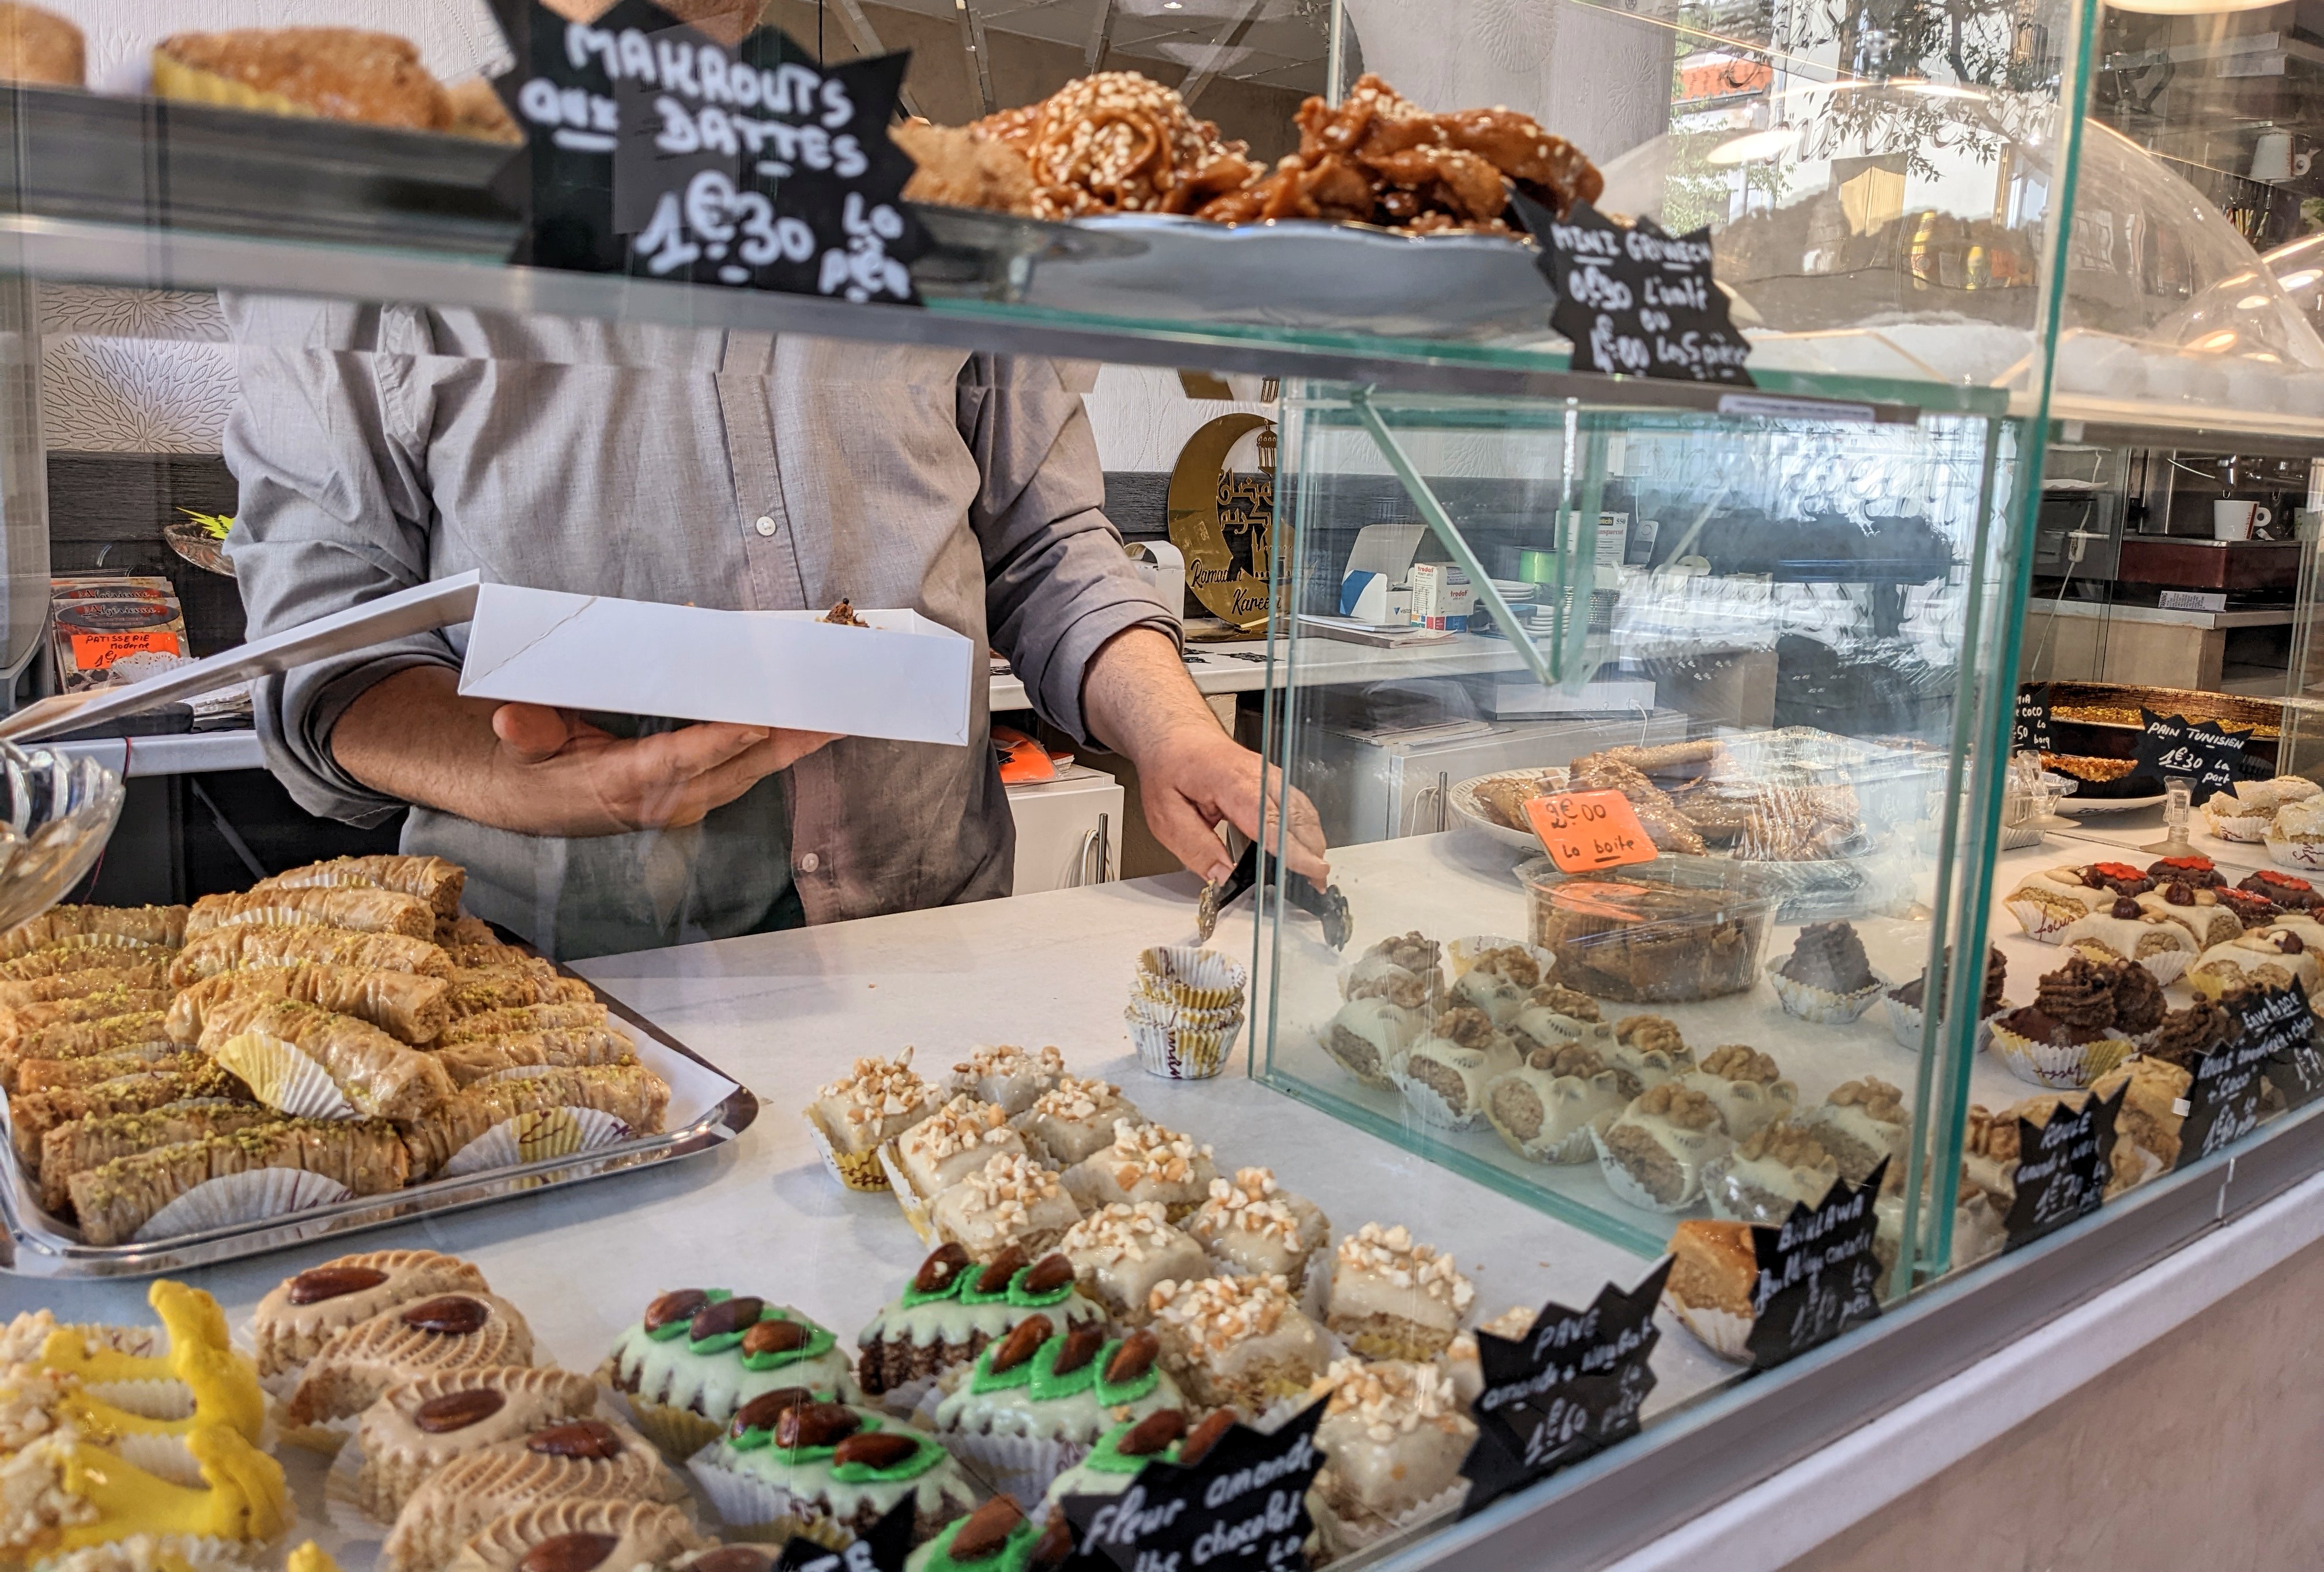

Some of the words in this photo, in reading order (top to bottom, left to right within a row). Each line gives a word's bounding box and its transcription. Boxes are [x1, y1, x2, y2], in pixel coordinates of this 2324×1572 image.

[564, 23, 855, 130] MAKROUTS
[652, 95, 869, 179] DATTES
[1190, 558, 1244, 589] Raman
[2146, 722, 2180, 737] PAIN
[2186, 727, 2245, 750] TUNISIEN
[2201, 772, 2230, 784] part
